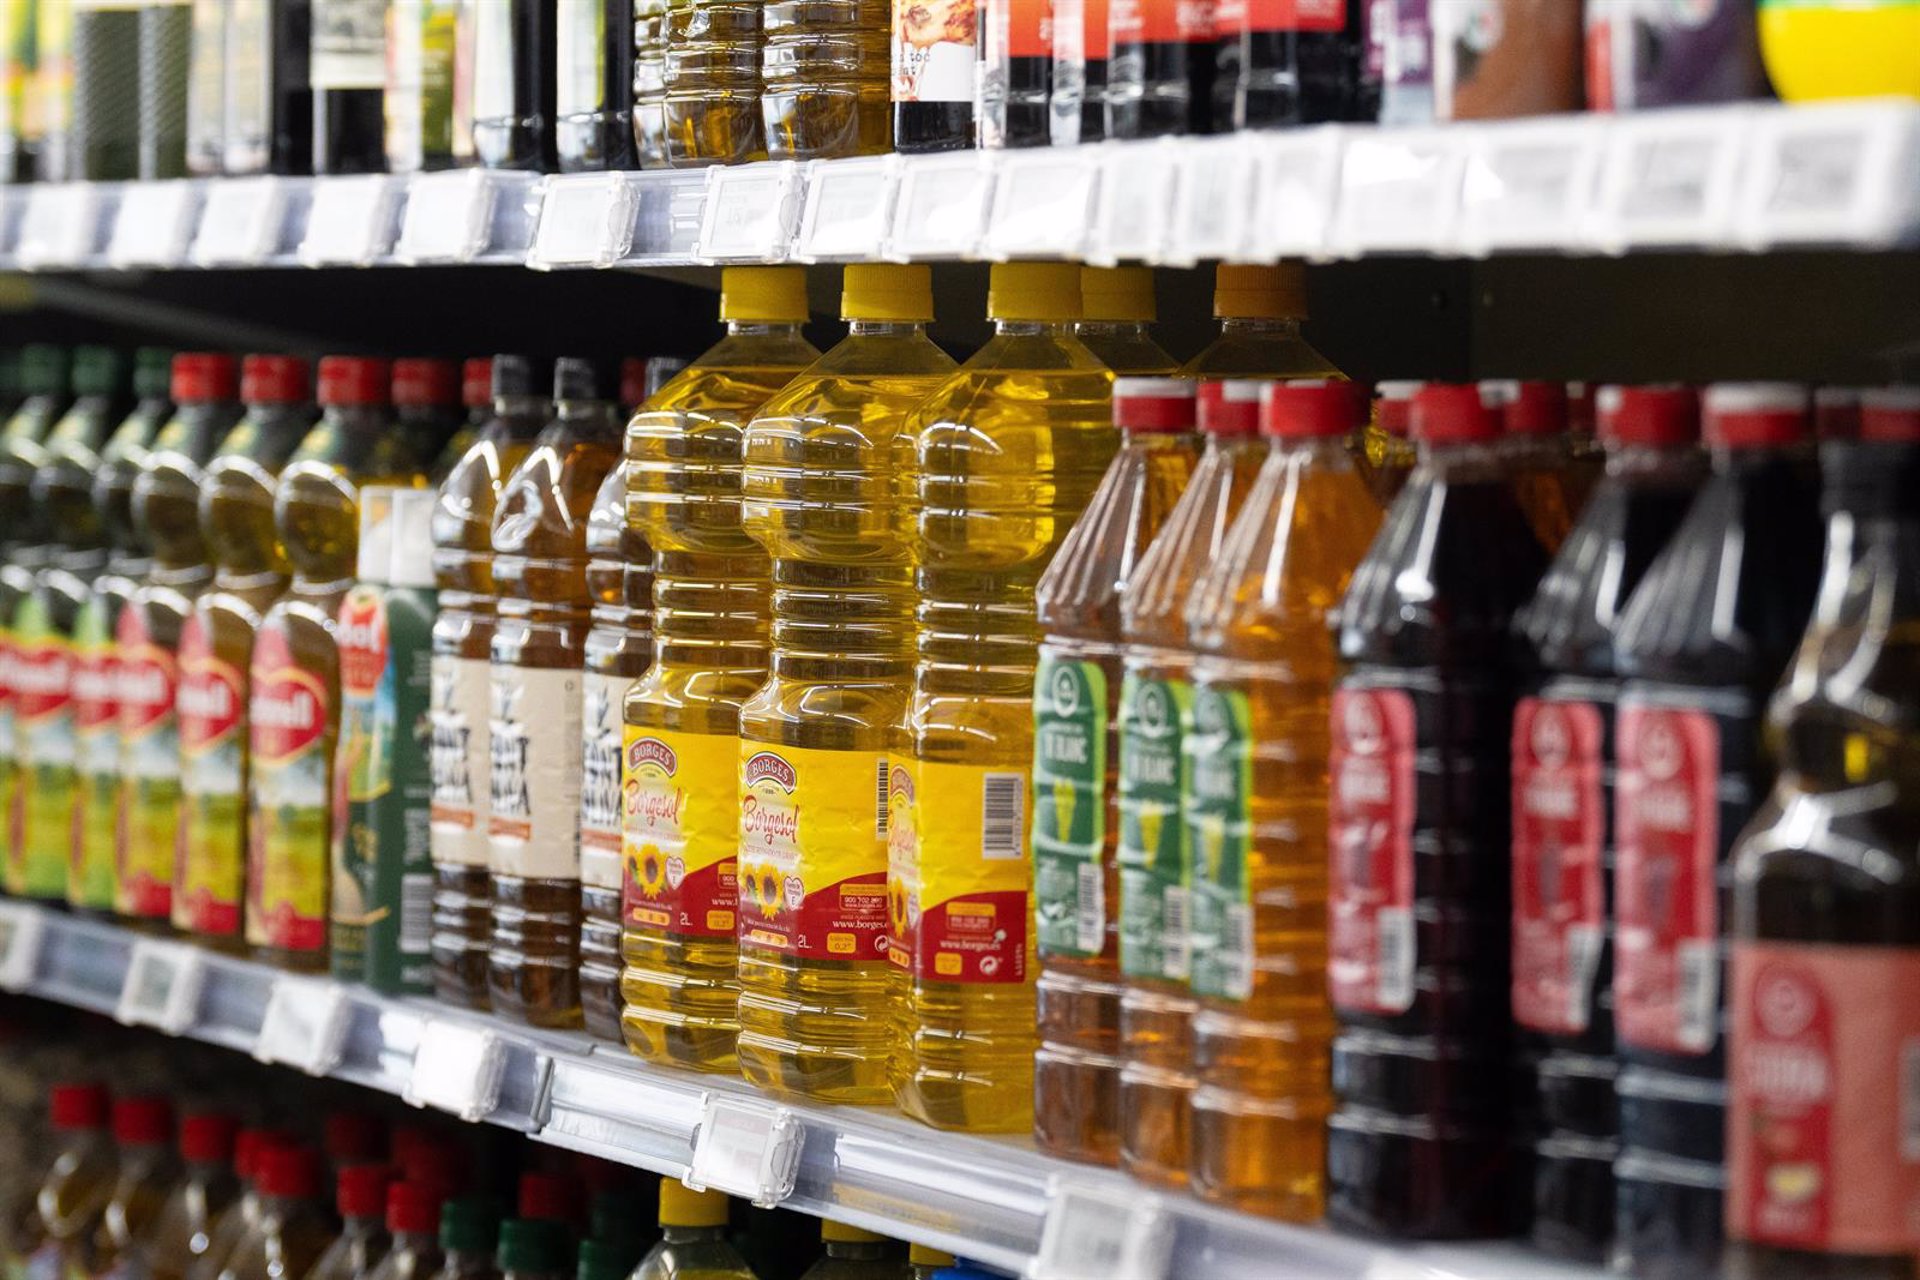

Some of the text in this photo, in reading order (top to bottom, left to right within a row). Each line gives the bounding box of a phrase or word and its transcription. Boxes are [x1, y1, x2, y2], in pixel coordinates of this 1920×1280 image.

[634, 742, 671, 765] BORGES
[752, 759, 789, 782] BORGES
[626, 779, 682, 828] Borgesol
[743, 795, 800, 845] Borgesol
